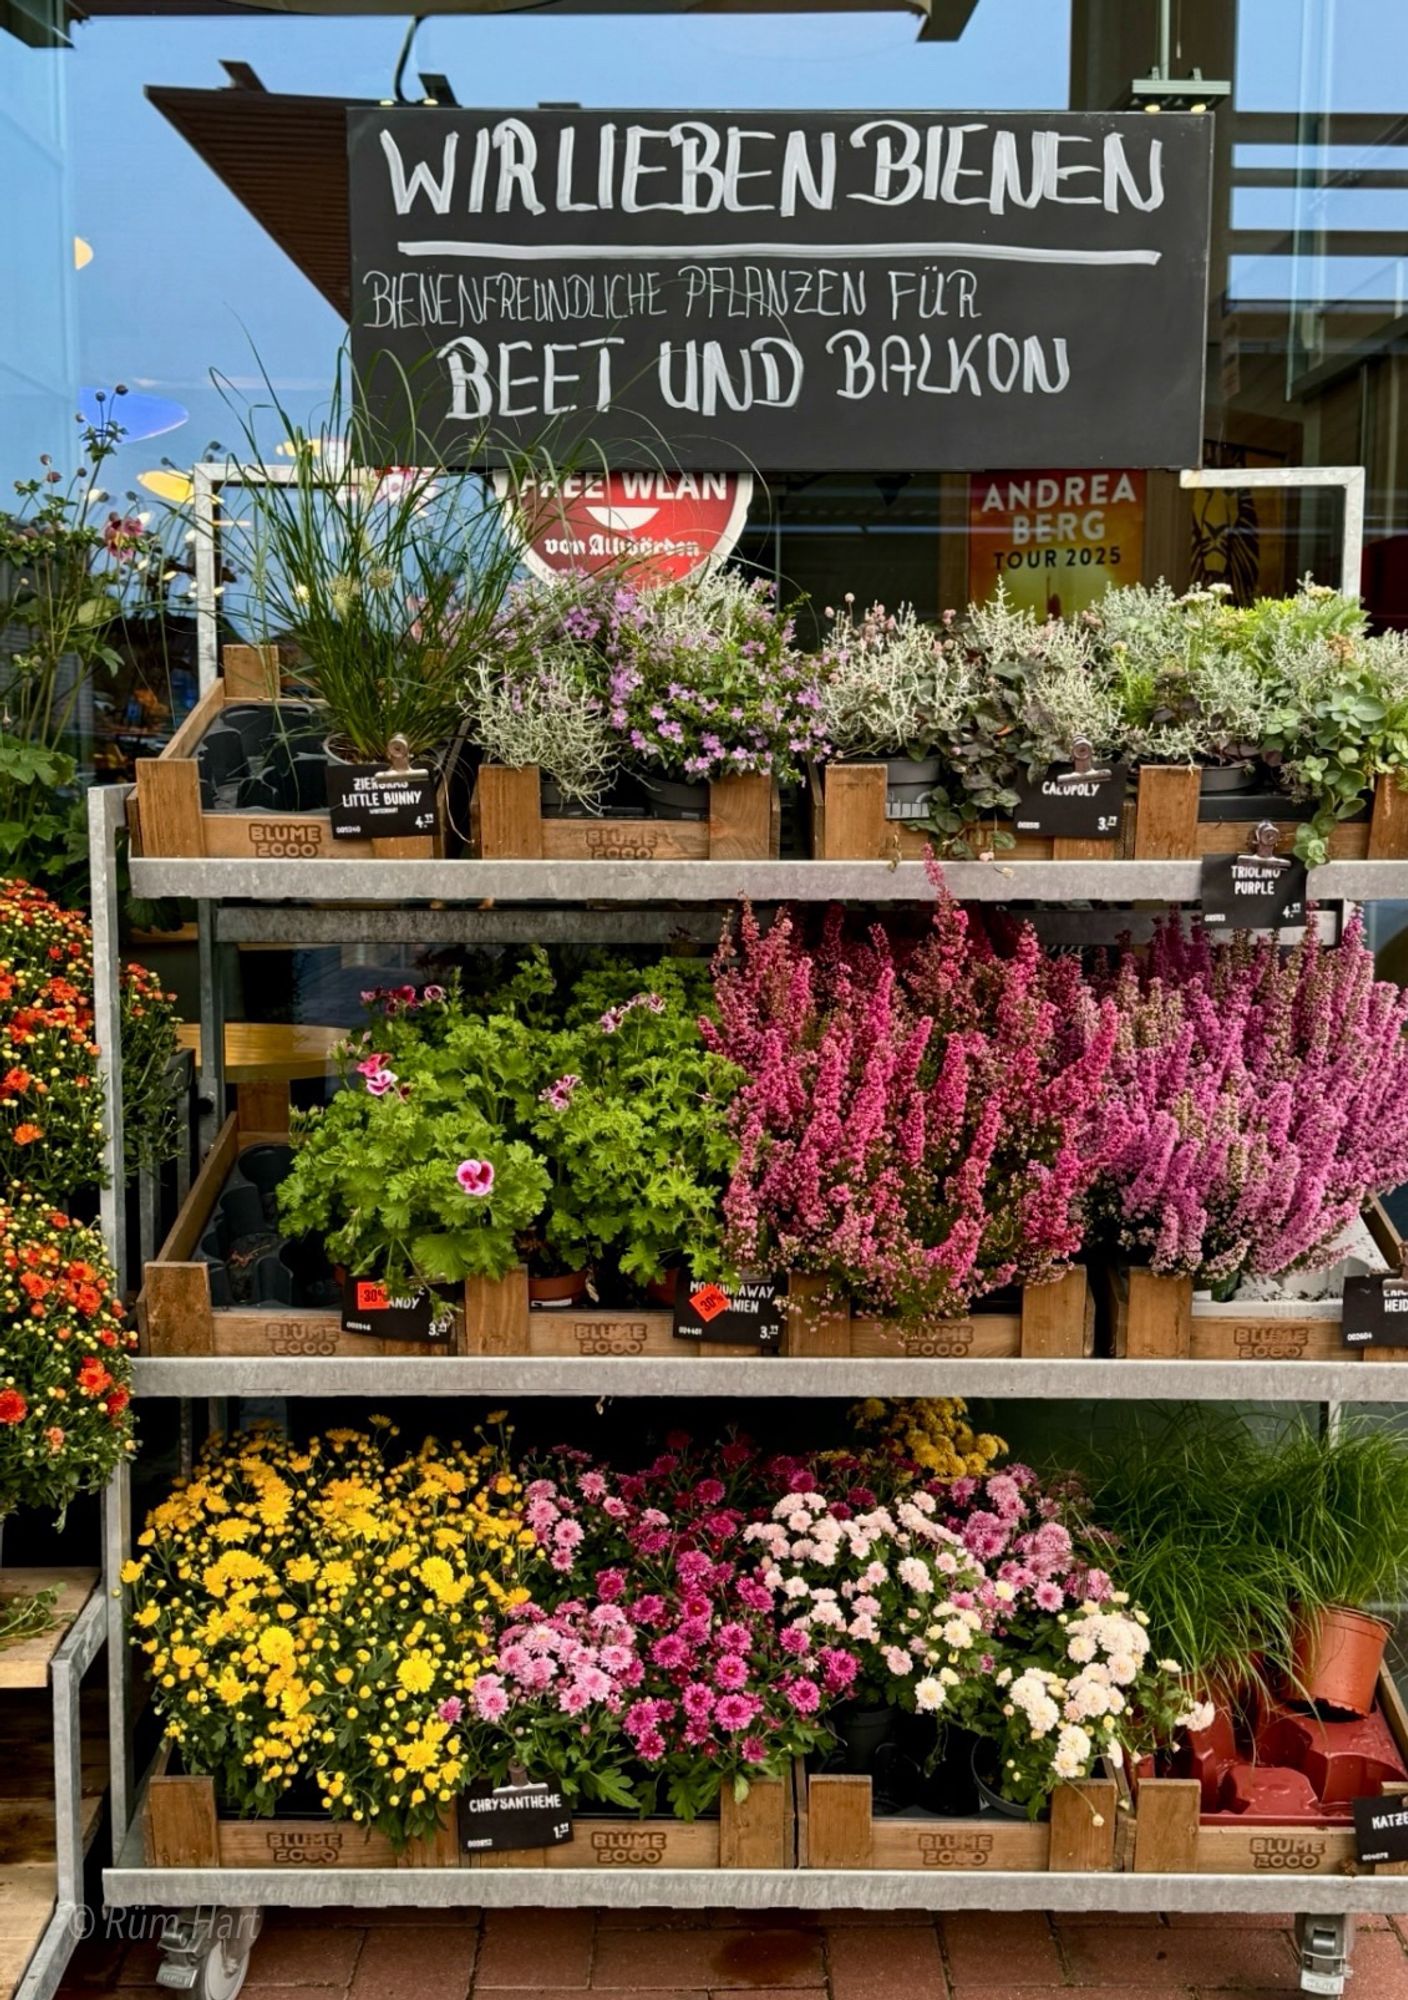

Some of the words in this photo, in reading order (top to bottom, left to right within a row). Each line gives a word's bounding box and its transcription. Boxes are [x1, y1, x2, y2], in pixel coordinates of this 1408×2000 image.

[381, 117, 546, 217] WIR
[556, 120, 836, 217] LIEBEN
[847, 119, 1166, 217] BIENEN
[363, 269, 662, 329] BIENENFREUNDLICHE
[678, 266, 867, 321] PFLANZEN
[890, 268, 982, 322] FÜR
[437, 336, 625, 420] BEET
[660, 337, 802, 417] UND
[827, 328, 1071, 400] BALKON
[622, 472, 727, 500] WLAN
[981, 472, 1137, 512] ANDREA
[1012, 511, 1106, 545] BERG
[544, 537, 586, 555] von
[993, 550, 1057, 570] TOUR
[1066, 546, 1122, 566] 2025
[342, 792, 380, 808] LITTLE
[383, 790, 422, 806] BUNNY
[249, 824, 321, 842] BLUME
[256, 842, 318, 858] 2000
[1234, 881, 1275, 895] PURPLE
[387, 1296, 420, 1310] ANDY
[266, 1323, 340, 1342] BLUME
[574, 1323, 648, 1341] BLUME
[904, 1325, 974, 1344] LUME
[1234, 1326, 1308, 1346] BLUME
[469, 1794, 562, 1814] CHRYSANTHEME
[266, 1832, 343, 1849] BLUME
[591, 1831, 667, 1850] BLUME
[918, 1832, 993, 1851] BLUME
[1250, 1837, 1326, 1854] BLUME
[597, 1849, 662, 1865] 2000
